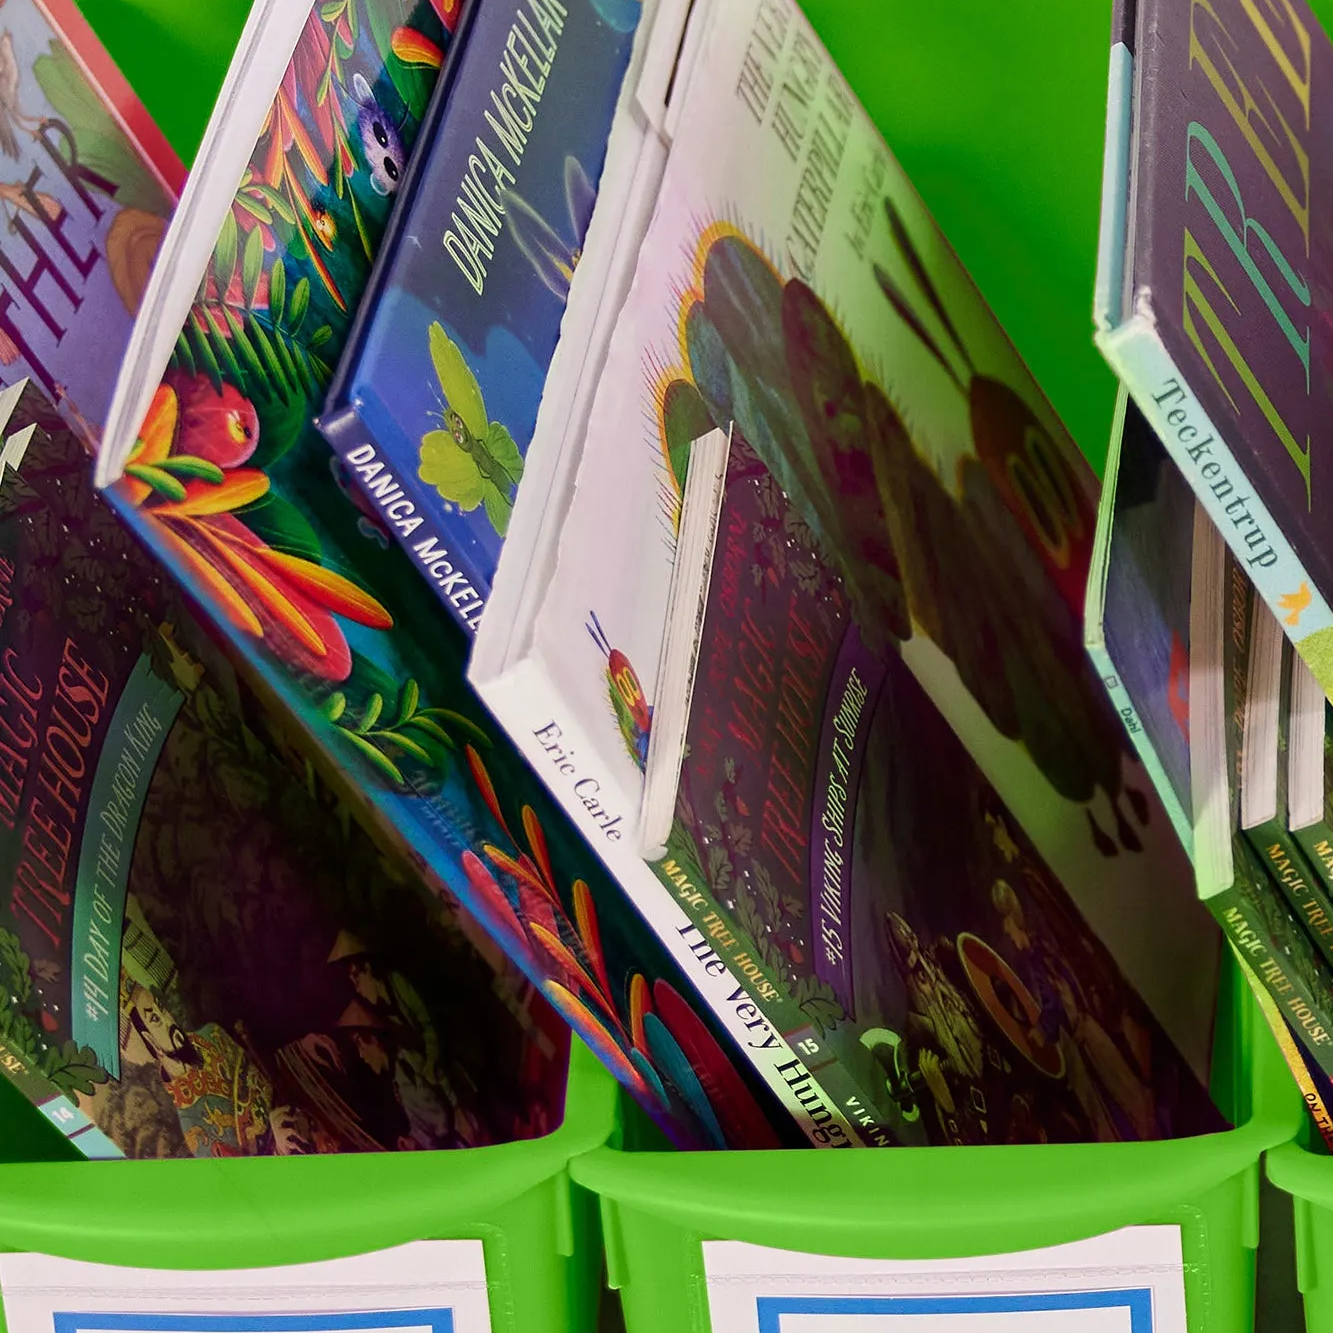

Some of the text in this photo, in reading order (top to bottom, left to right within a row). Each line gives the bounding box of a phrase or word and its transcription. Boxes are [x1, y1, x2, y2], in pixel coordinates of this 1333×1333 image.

[442, 137, 516, 296] DANICA
[346, 443, 425, 538] DANICA
[1152, 378, 1279, 569] Teckentrup
[760, 588, 828, 885] TREE HOUSE
[1120, 707, 1142, 734] Dahl
[10, 636, 110, 951] TREE HOUSE
[532, 718, 622, 842] Eric Carle
[820, 668, 868, 965] #15 VIKING SHIPS AT SUNRISE
[83, 702, 163, 1024] #14 DAY OF THE DRAGON KING
[661, 859, 709, 912] MAGIC
[702, 910, 740, 952] TREE
[1266, 843, 1309, 897] MAGIC
[1222, 906, 1267, 957] MAGIC
[1260, 957, 1295, 996] TREE
[726, 986, 783, 1052] Very
[798, 1038, 820, 1055] 15
[51, 1106, 75, 1124] 14
[1303, 1092, 1322, 1113] ON
